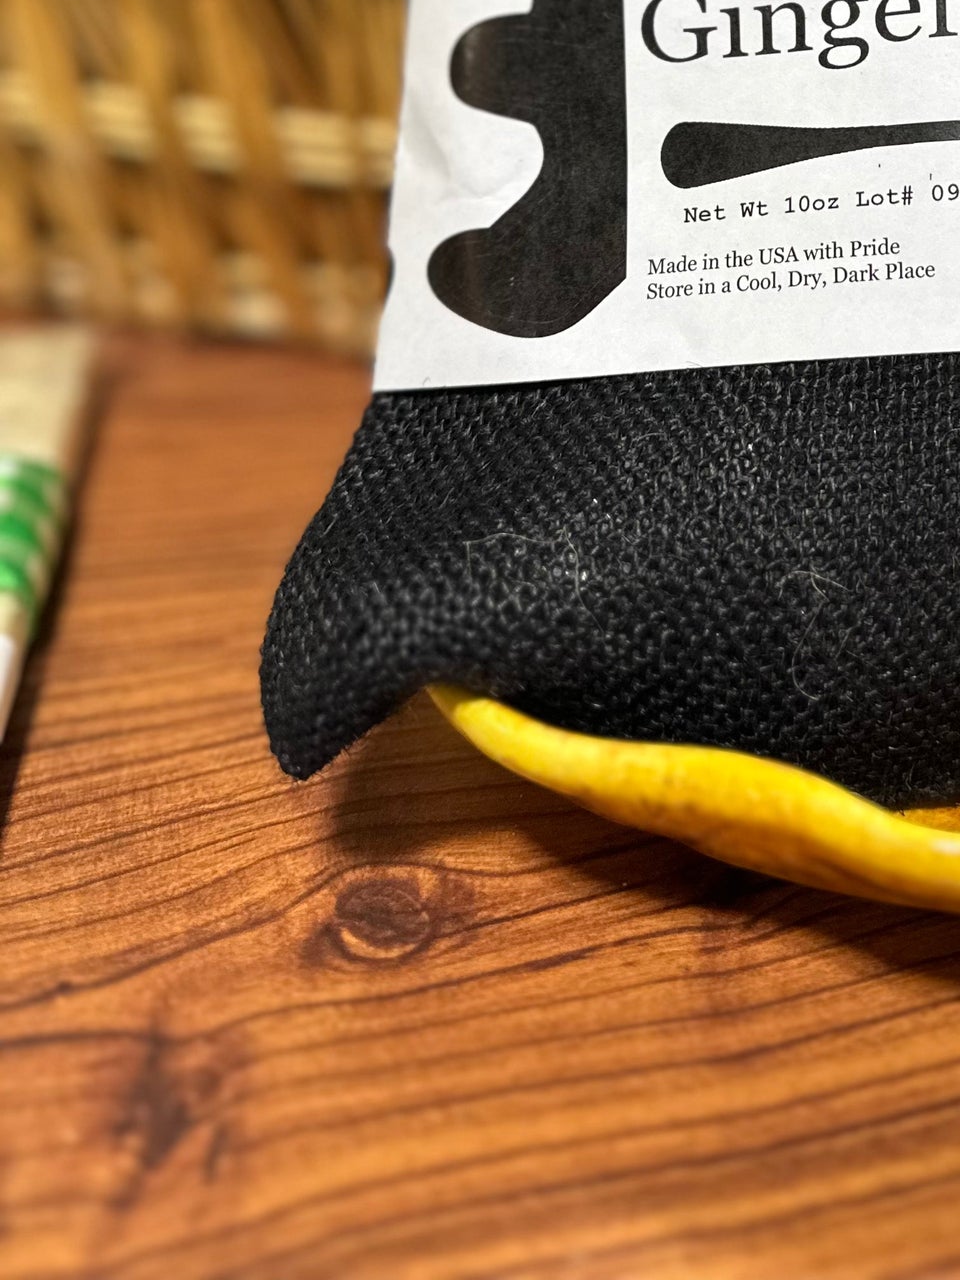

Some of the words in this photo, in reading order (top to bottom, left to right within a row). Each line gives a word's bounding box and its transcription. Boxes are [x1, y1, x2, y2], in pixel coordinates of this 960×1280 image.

[683, 205, 726, 223] Net
[740, 201, 769, 219] Wt
[784, 195, 840, 215] 10oz
[855, 185, 914, 208] Lot#
[647, 256, 698, 276] Made
[702, 253, 720, 271] in
[724, 249, 754, 269] the
[758, 247, 799, 266] USA
[803, 241, 844, 261] with
[850, 237, 901, 258] Pride
[646, 283, 694, 300] Store
[698, 278, 716, 296] in
[721, 281, 732, 294] a
[736, 272, 783, 294] Cool,
[788, 269, 828, 291] Dry,
[832, 263, 881, 285] Dark
[885, 261, 937, 281] Place
